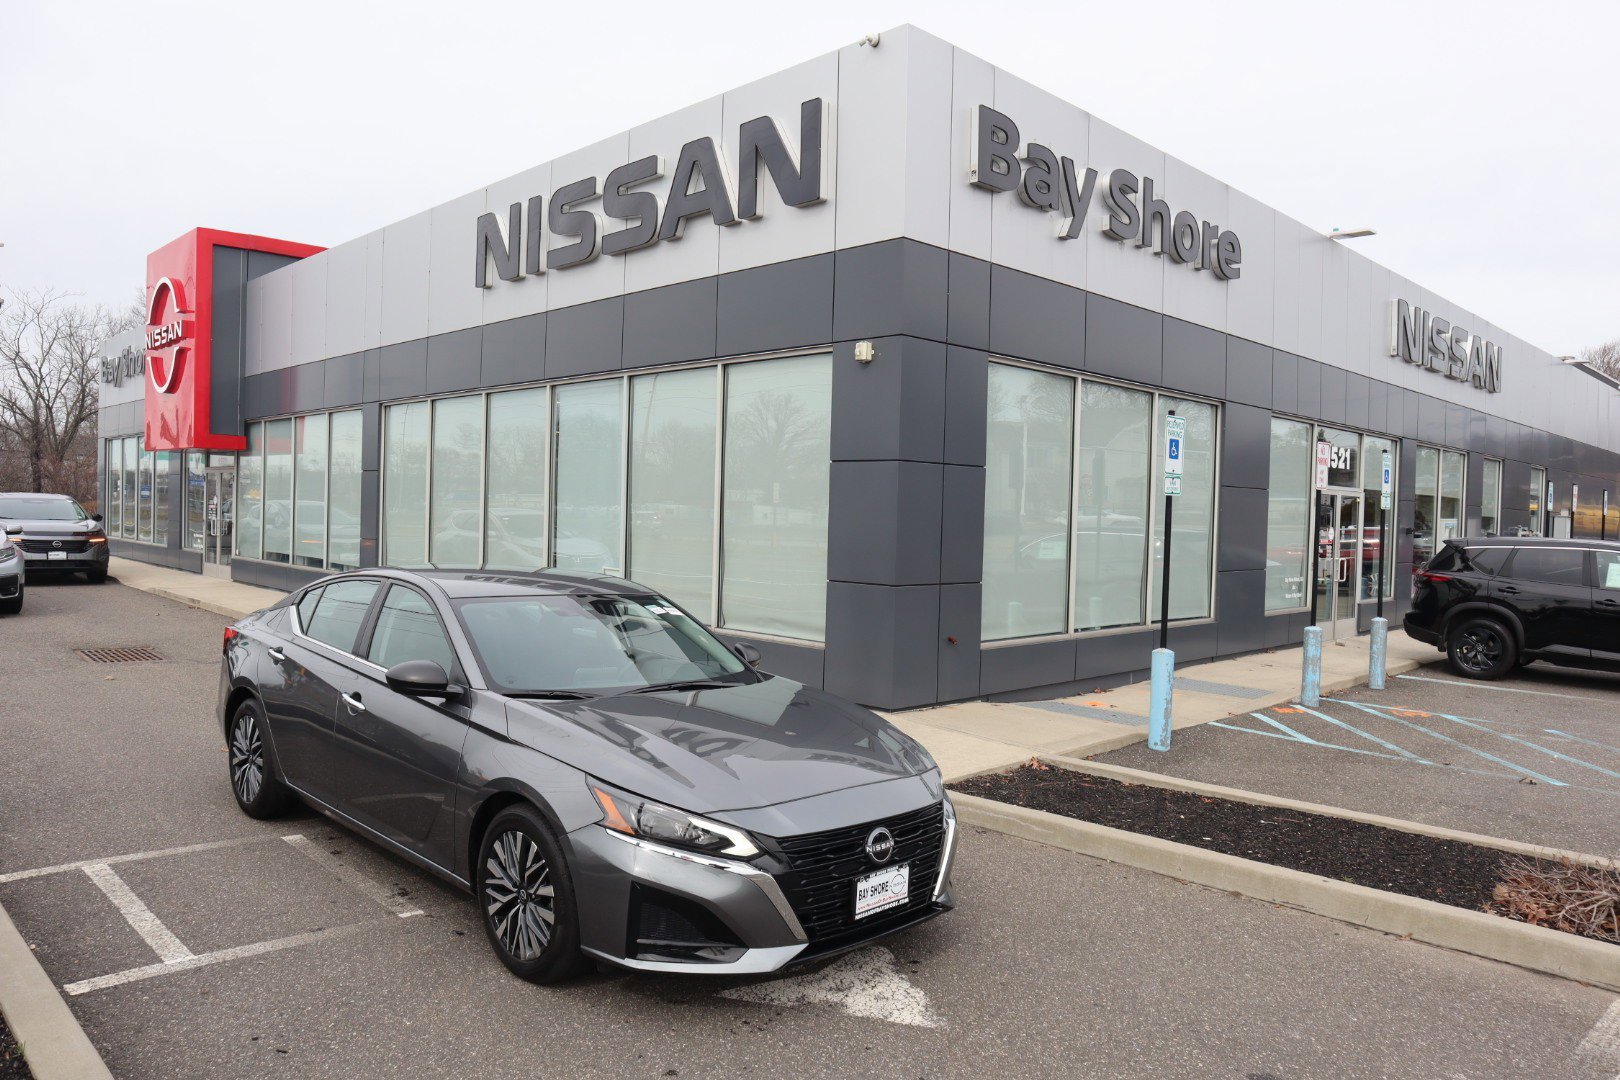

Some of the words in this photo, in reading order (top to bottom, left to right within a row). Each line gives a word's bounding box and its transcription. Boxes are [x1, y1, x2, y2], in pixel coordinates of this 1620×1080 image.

[475, 97, 826, 289] NISSAN
[969, 104, 1099, 240] Bay
[1102, 168, 1242, 280] Shore
[146, 320, 183, 350] NISSAN
[1390, 298, 1503, 393] NISSAN
[101, 356, 122, 388] Bay
[866, 841, 894, 853] NISSAN
[858, 888, 869, 902] BAY
[870, 881, 889, 897] SHORE
